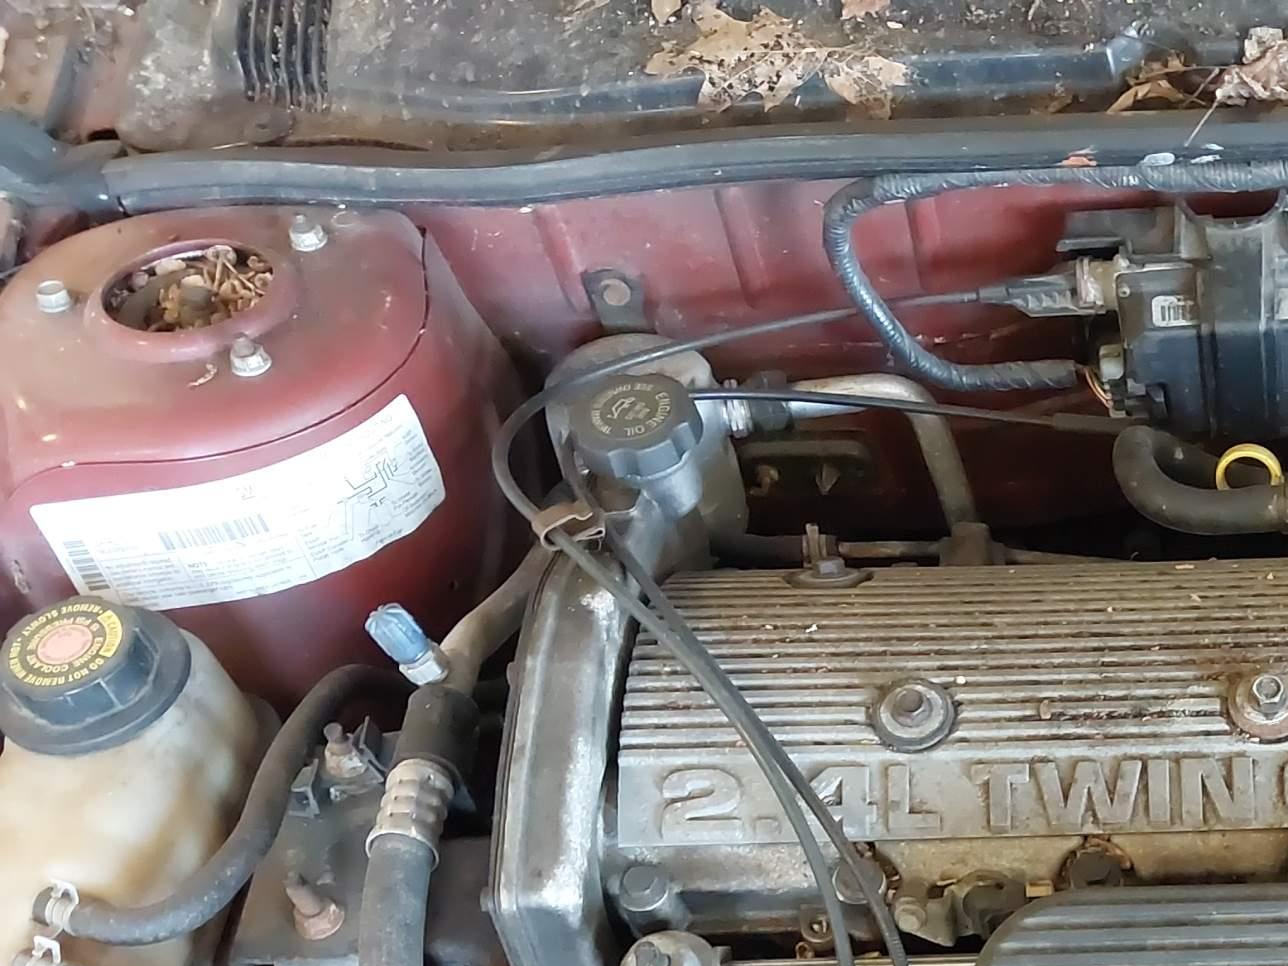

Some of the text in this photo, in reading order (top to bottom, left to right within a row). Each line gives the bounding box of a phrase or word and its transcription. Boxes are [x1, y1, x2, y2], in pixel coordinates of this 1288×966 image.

[646, 392, 671, 428] ENGINE
[624, 425, 645, 436] OIL
[22, 603, 101, 637] REMOVE SLOWLY
[88, 657, 105, 670] DO
[24, 673, 66, 687] REMOVE
[67, 668, 90, 682] NOT
[977, 756, 1257, 831] TWIN
